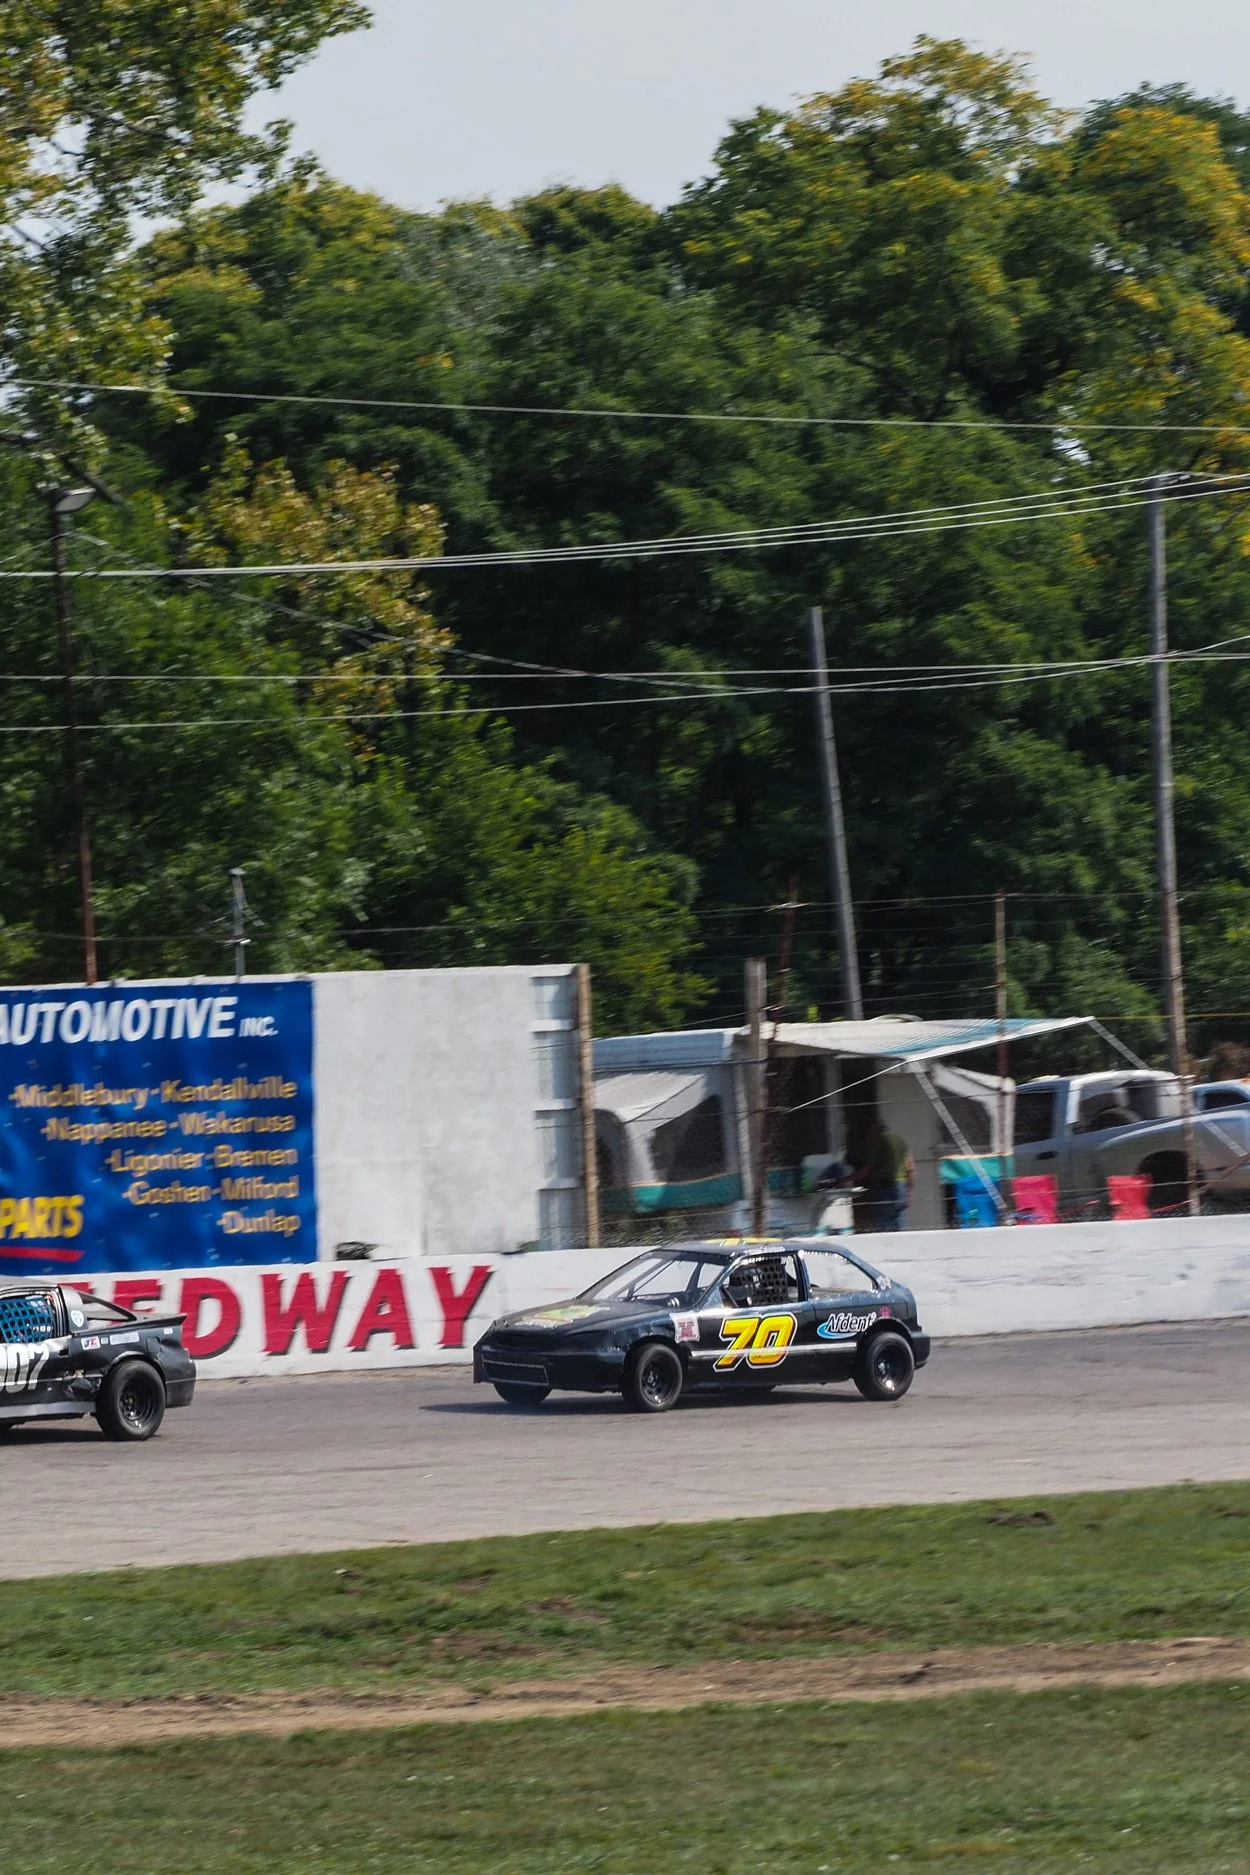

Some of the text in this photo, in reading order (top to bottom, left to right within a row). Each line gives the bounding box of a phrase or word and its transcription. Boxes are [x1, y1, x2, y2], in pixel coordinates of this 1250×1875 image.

[240, 1015, 279, 1038] INC.
[178, 1110, 296, 1136] Wakarusa
[213, 1144, 298, 1168] Bremen
[221, 1208, 301, 1238] Dunlap
[713, 1311, 797, 1372] 70
